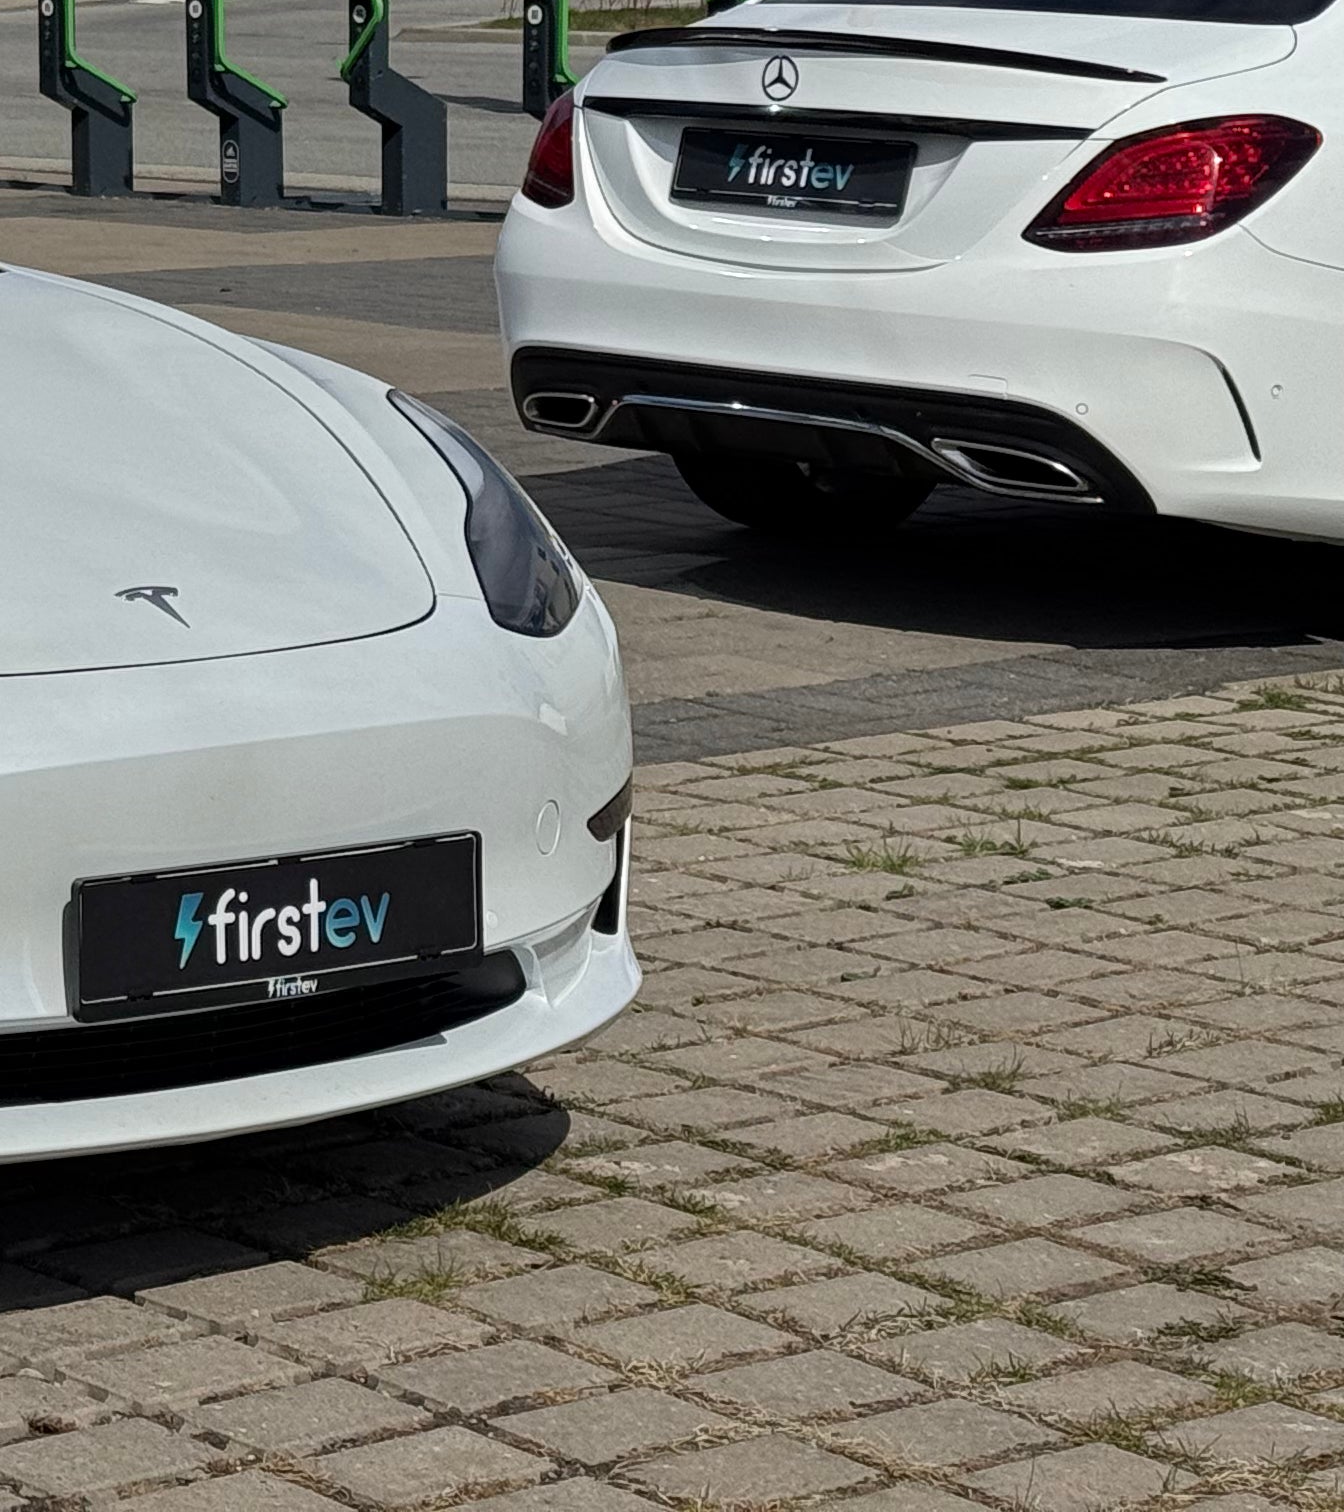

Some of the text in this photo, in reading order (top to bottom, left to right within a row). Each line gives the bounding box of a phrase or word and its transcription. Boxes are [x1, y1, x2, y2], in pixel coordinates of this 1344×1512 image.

[748, 145, 855, 191] firstev
[207, 878, 391, 965] firstev
[275, 976, 318, 999] firstev
